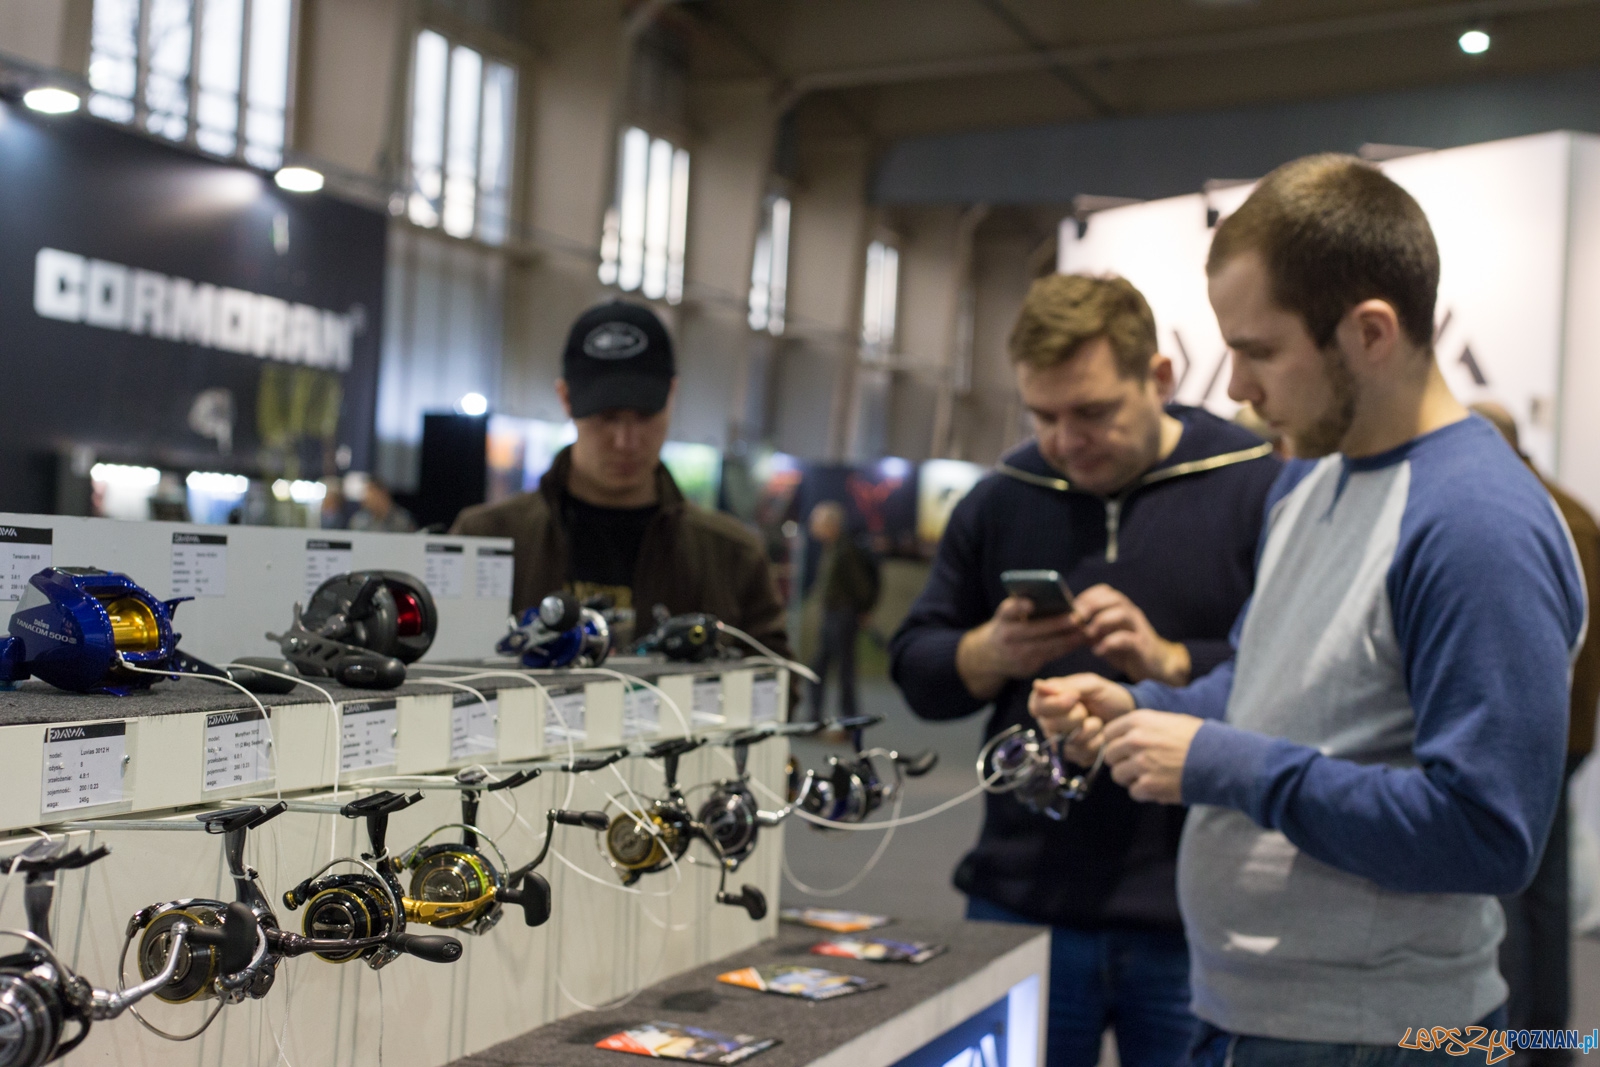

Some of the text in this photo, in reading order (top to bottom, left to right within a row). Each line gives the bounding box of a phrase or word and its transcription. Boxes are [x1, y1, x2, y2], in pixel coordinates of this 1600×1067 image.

[34, 246, 355, 371] CORMORAN
[16, 617, 49, 637] TANACOM
[208, 713, 239, 725] DAIWA
[49, 727, 86, 740] DAIWA
[80, 748, 95, 756] Luvias
